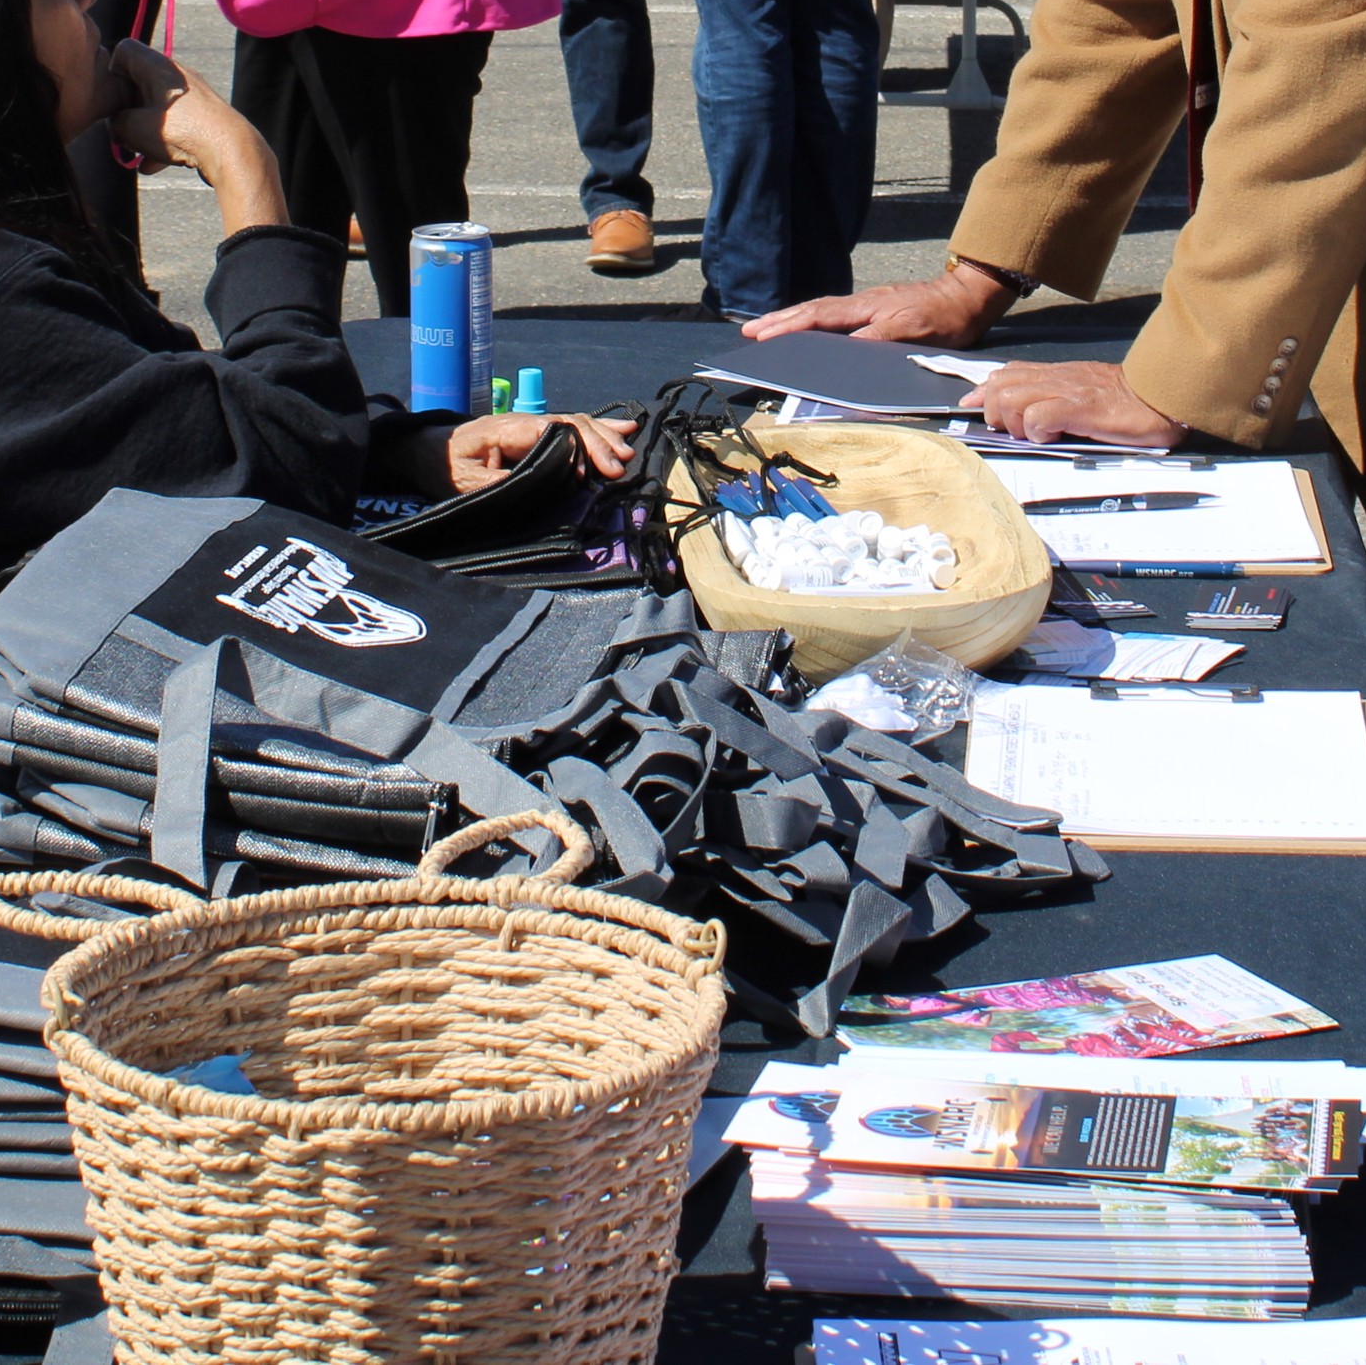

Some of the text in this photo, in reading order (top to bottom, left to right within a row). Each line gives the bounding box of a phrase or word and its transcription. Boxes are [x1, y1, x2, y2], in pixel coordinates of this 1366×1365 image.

[257, 556, 355, 634] WSNARC
[1126, 970, 1187, 1008] Spring Fair
[933, 1098, 977, 1149] WSNARC
[1044, 1125, 1063, 1140] CAN
[1041, 1141, 1060, 1153] WE
